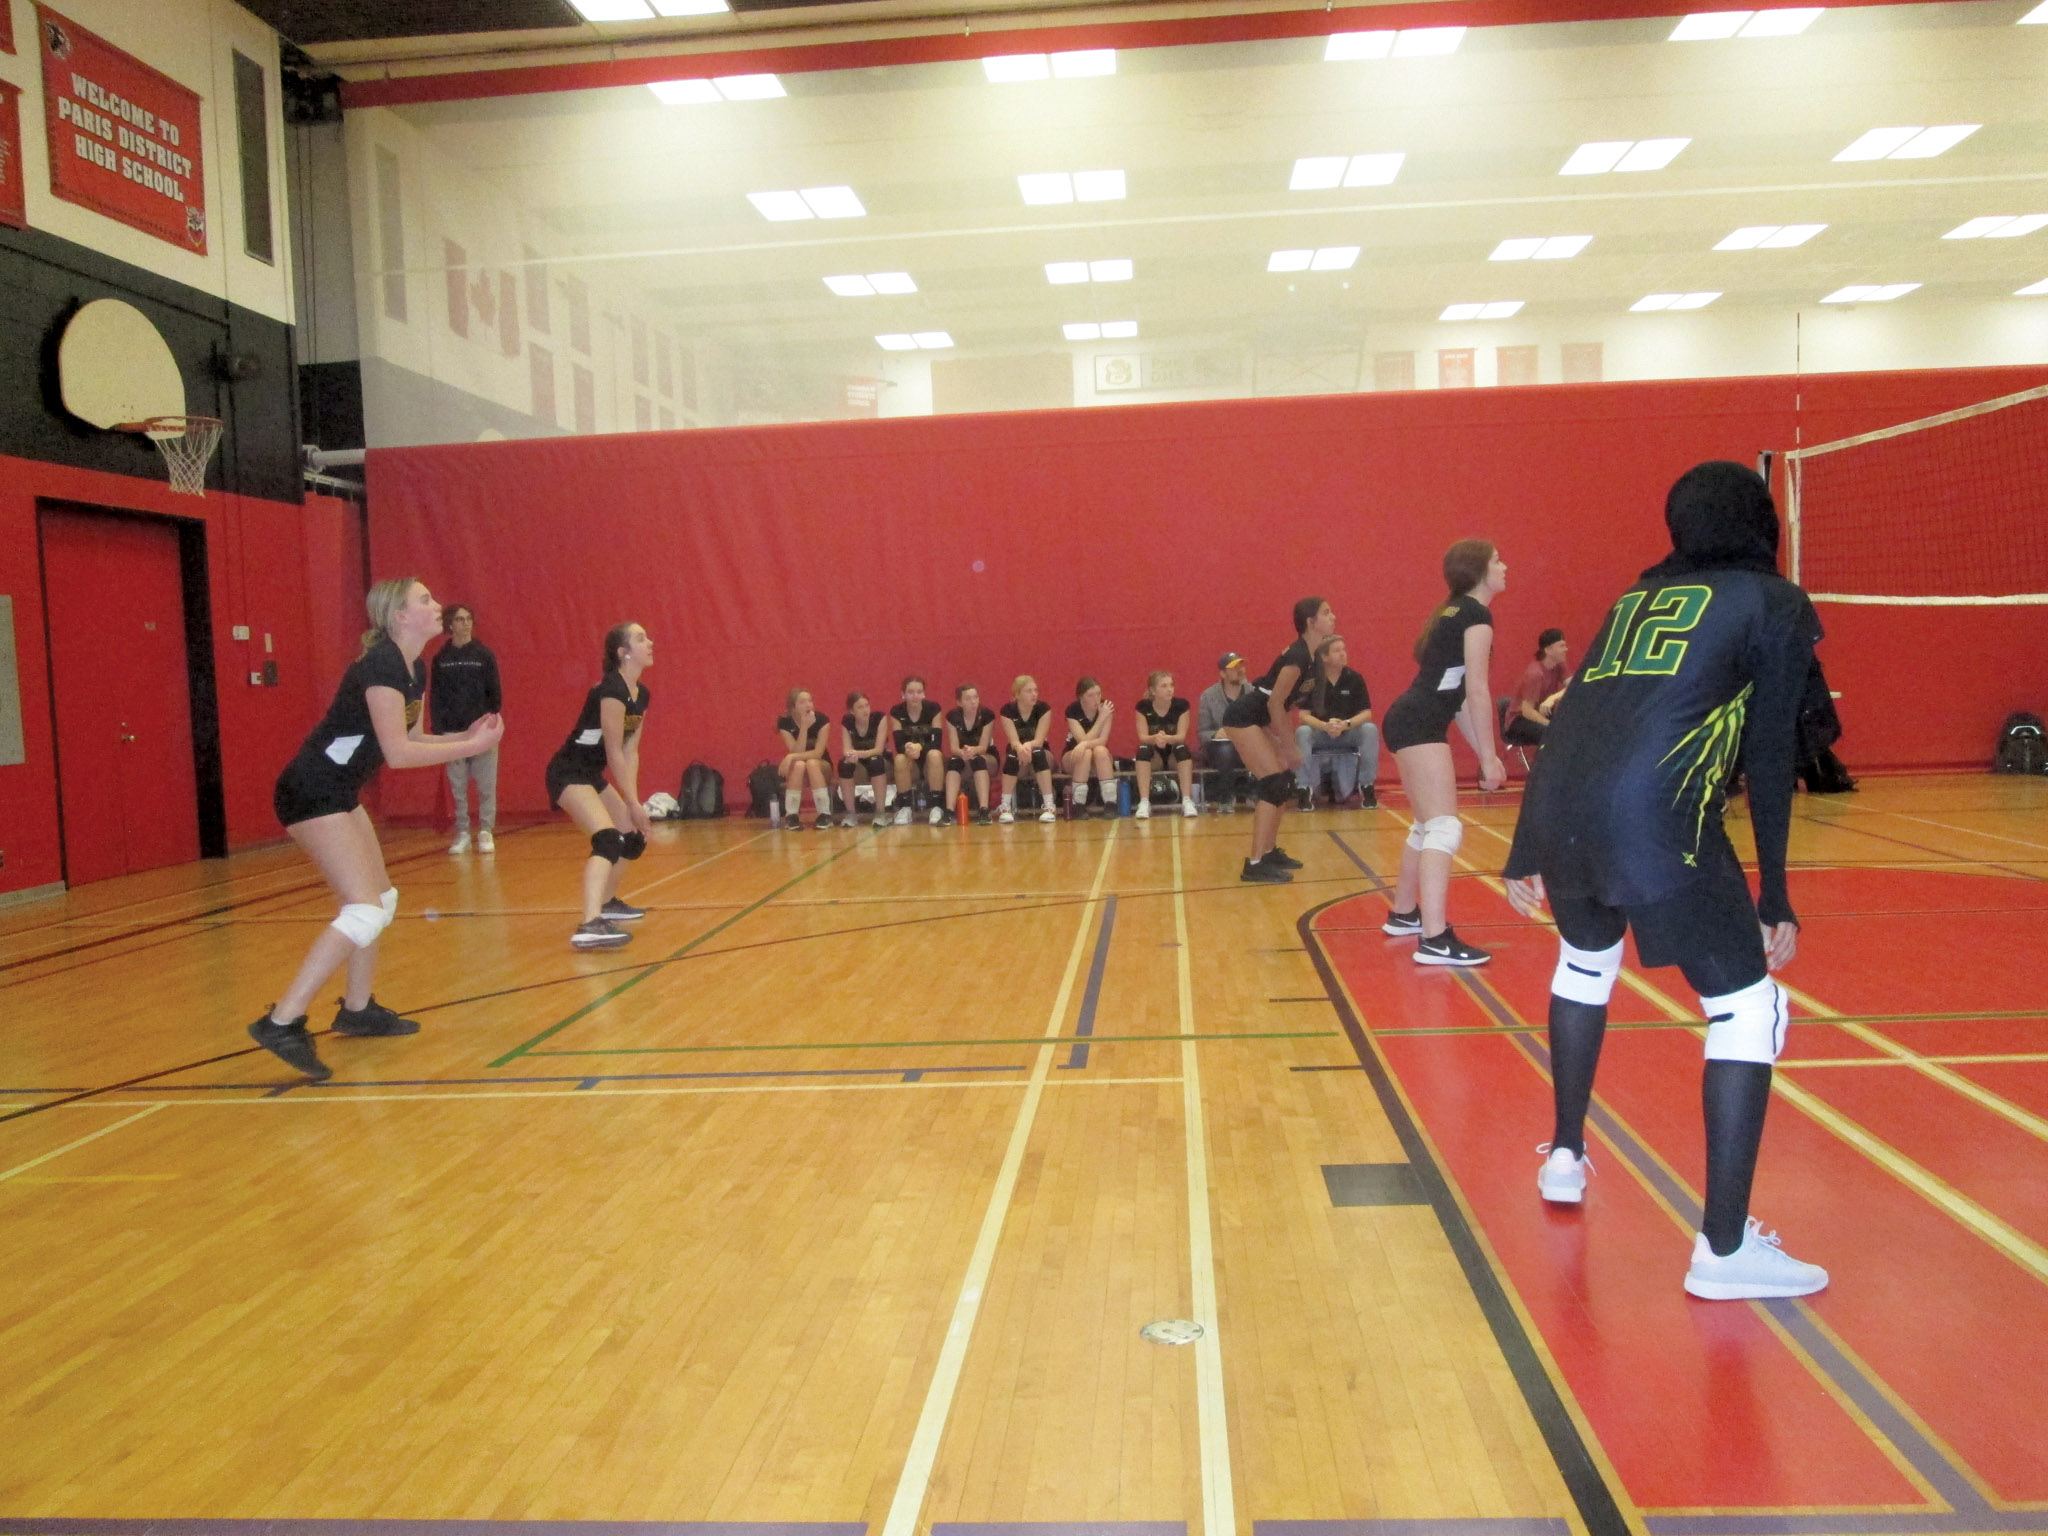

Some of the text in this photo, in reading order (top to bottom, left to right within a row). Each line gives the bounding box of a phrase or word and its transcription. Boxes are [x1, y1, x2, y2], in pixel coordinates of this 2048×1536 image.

[58, 96, 192, 179] PARIS DISTRICT
[71, 72, 180, 147] WELCOME TO
[74, 133, 185, 202] HIGH SCHOOL
[1583, 584, 1713, 682] 12
